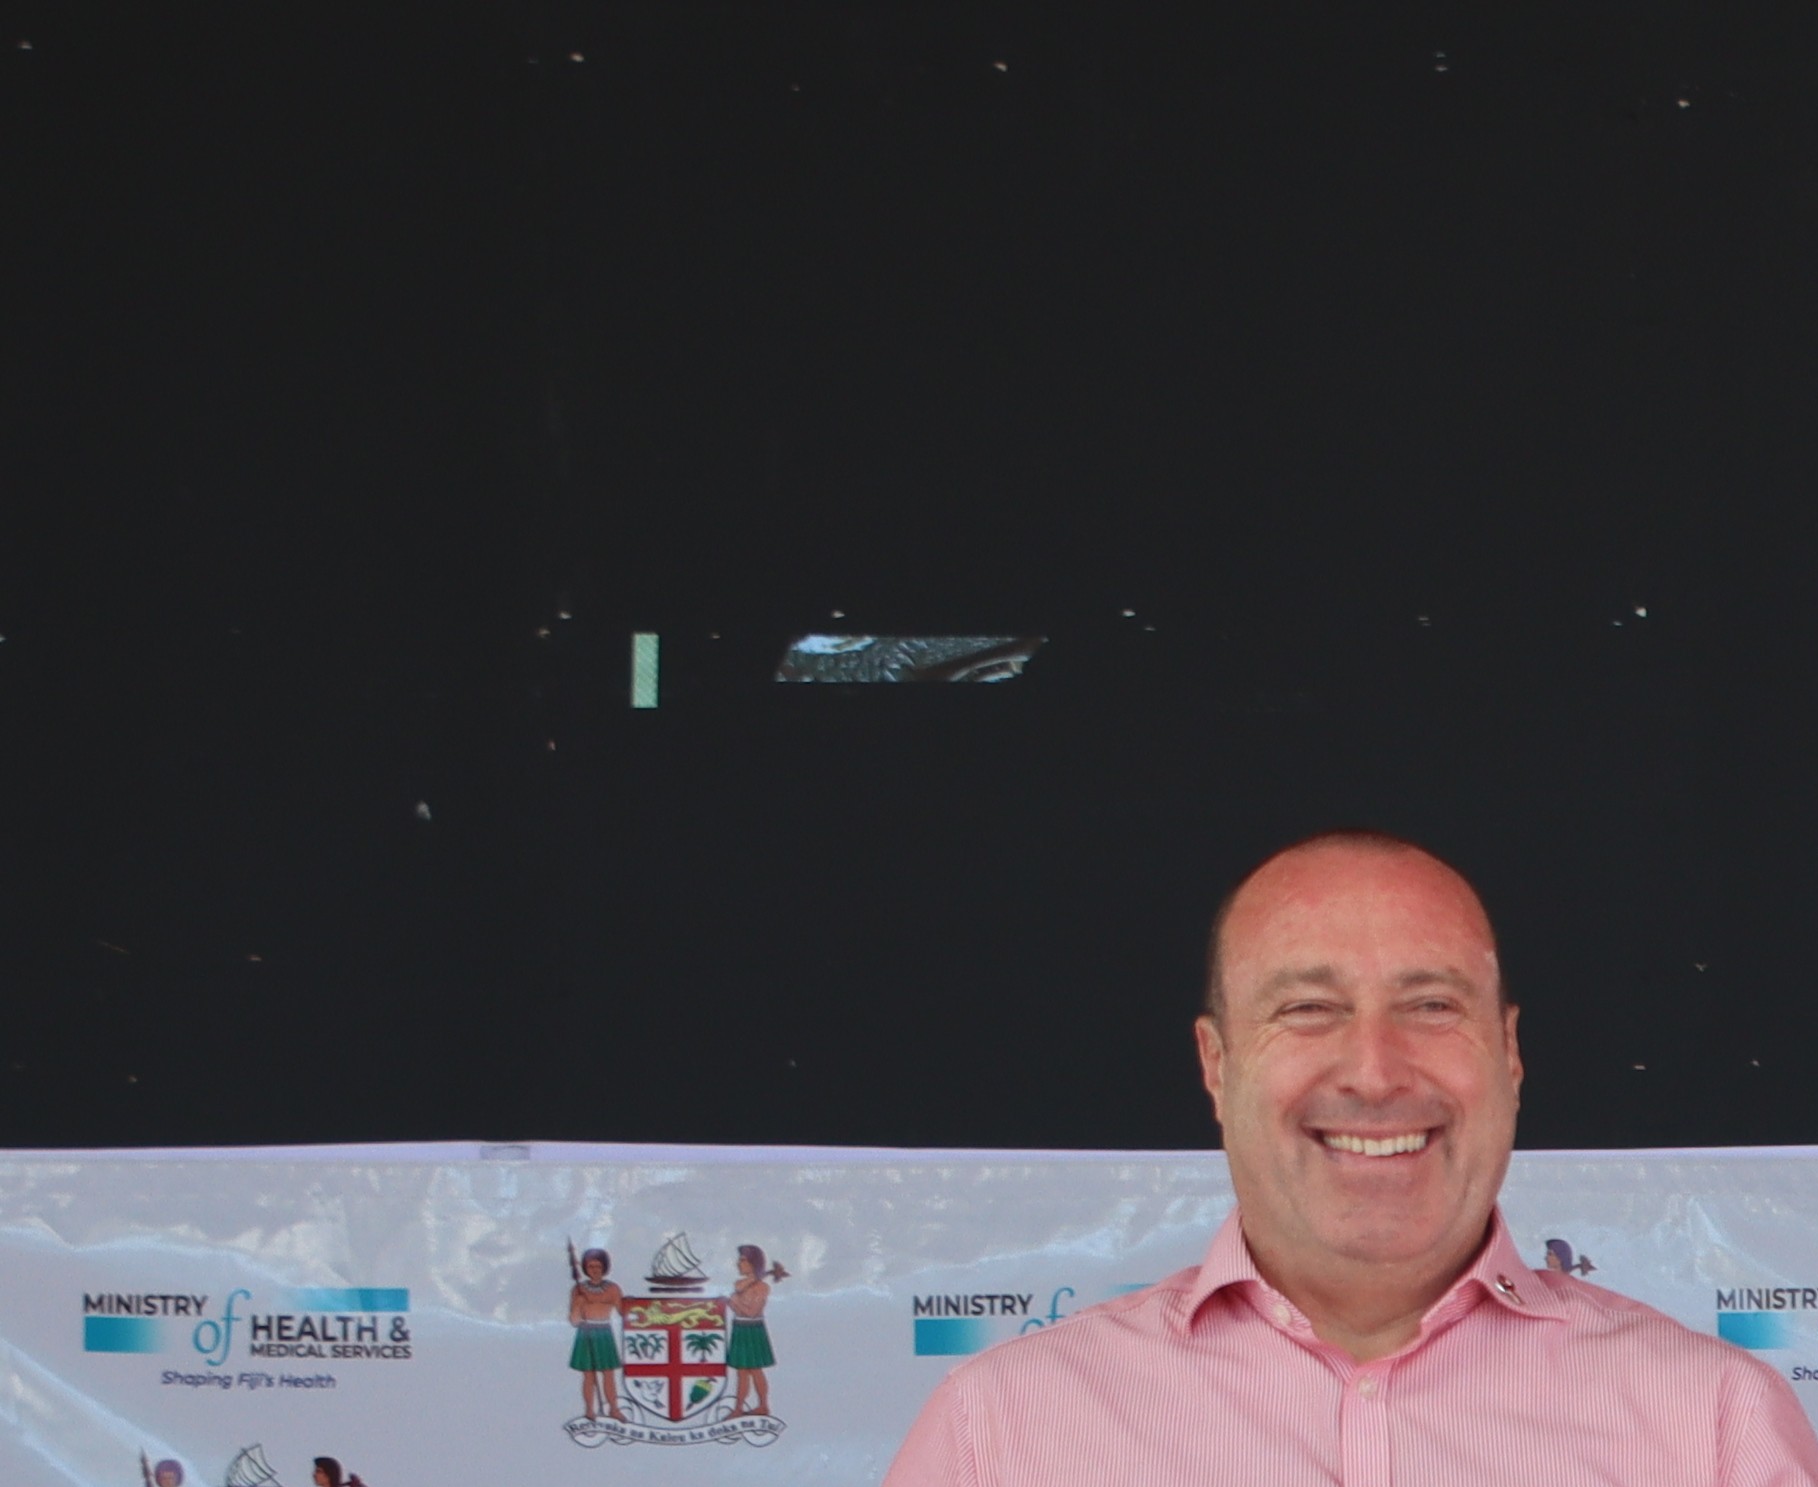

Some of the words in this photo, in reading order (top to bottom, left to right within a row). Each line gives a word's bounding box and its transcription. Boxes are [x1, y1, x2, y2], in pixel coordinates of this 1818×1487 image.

[915, 1293, 1034, 1316] MINISTRY
[84, 1293, 207, 1317] MINISTRY
[194, 1289, 250, 1367] of
[251, 1315, 378, 1342] HEALTH
[389, 1317, 410, 1342] &
[250, 1343, 326, 1358] MEDICAL
[332, 1343, 412, 1359] SERVICES
[161, 1372, 232, 1389] Shaping
[237, 1373, 274, 1389] Fiji's
[279, 1373, 336, 1389] Health
